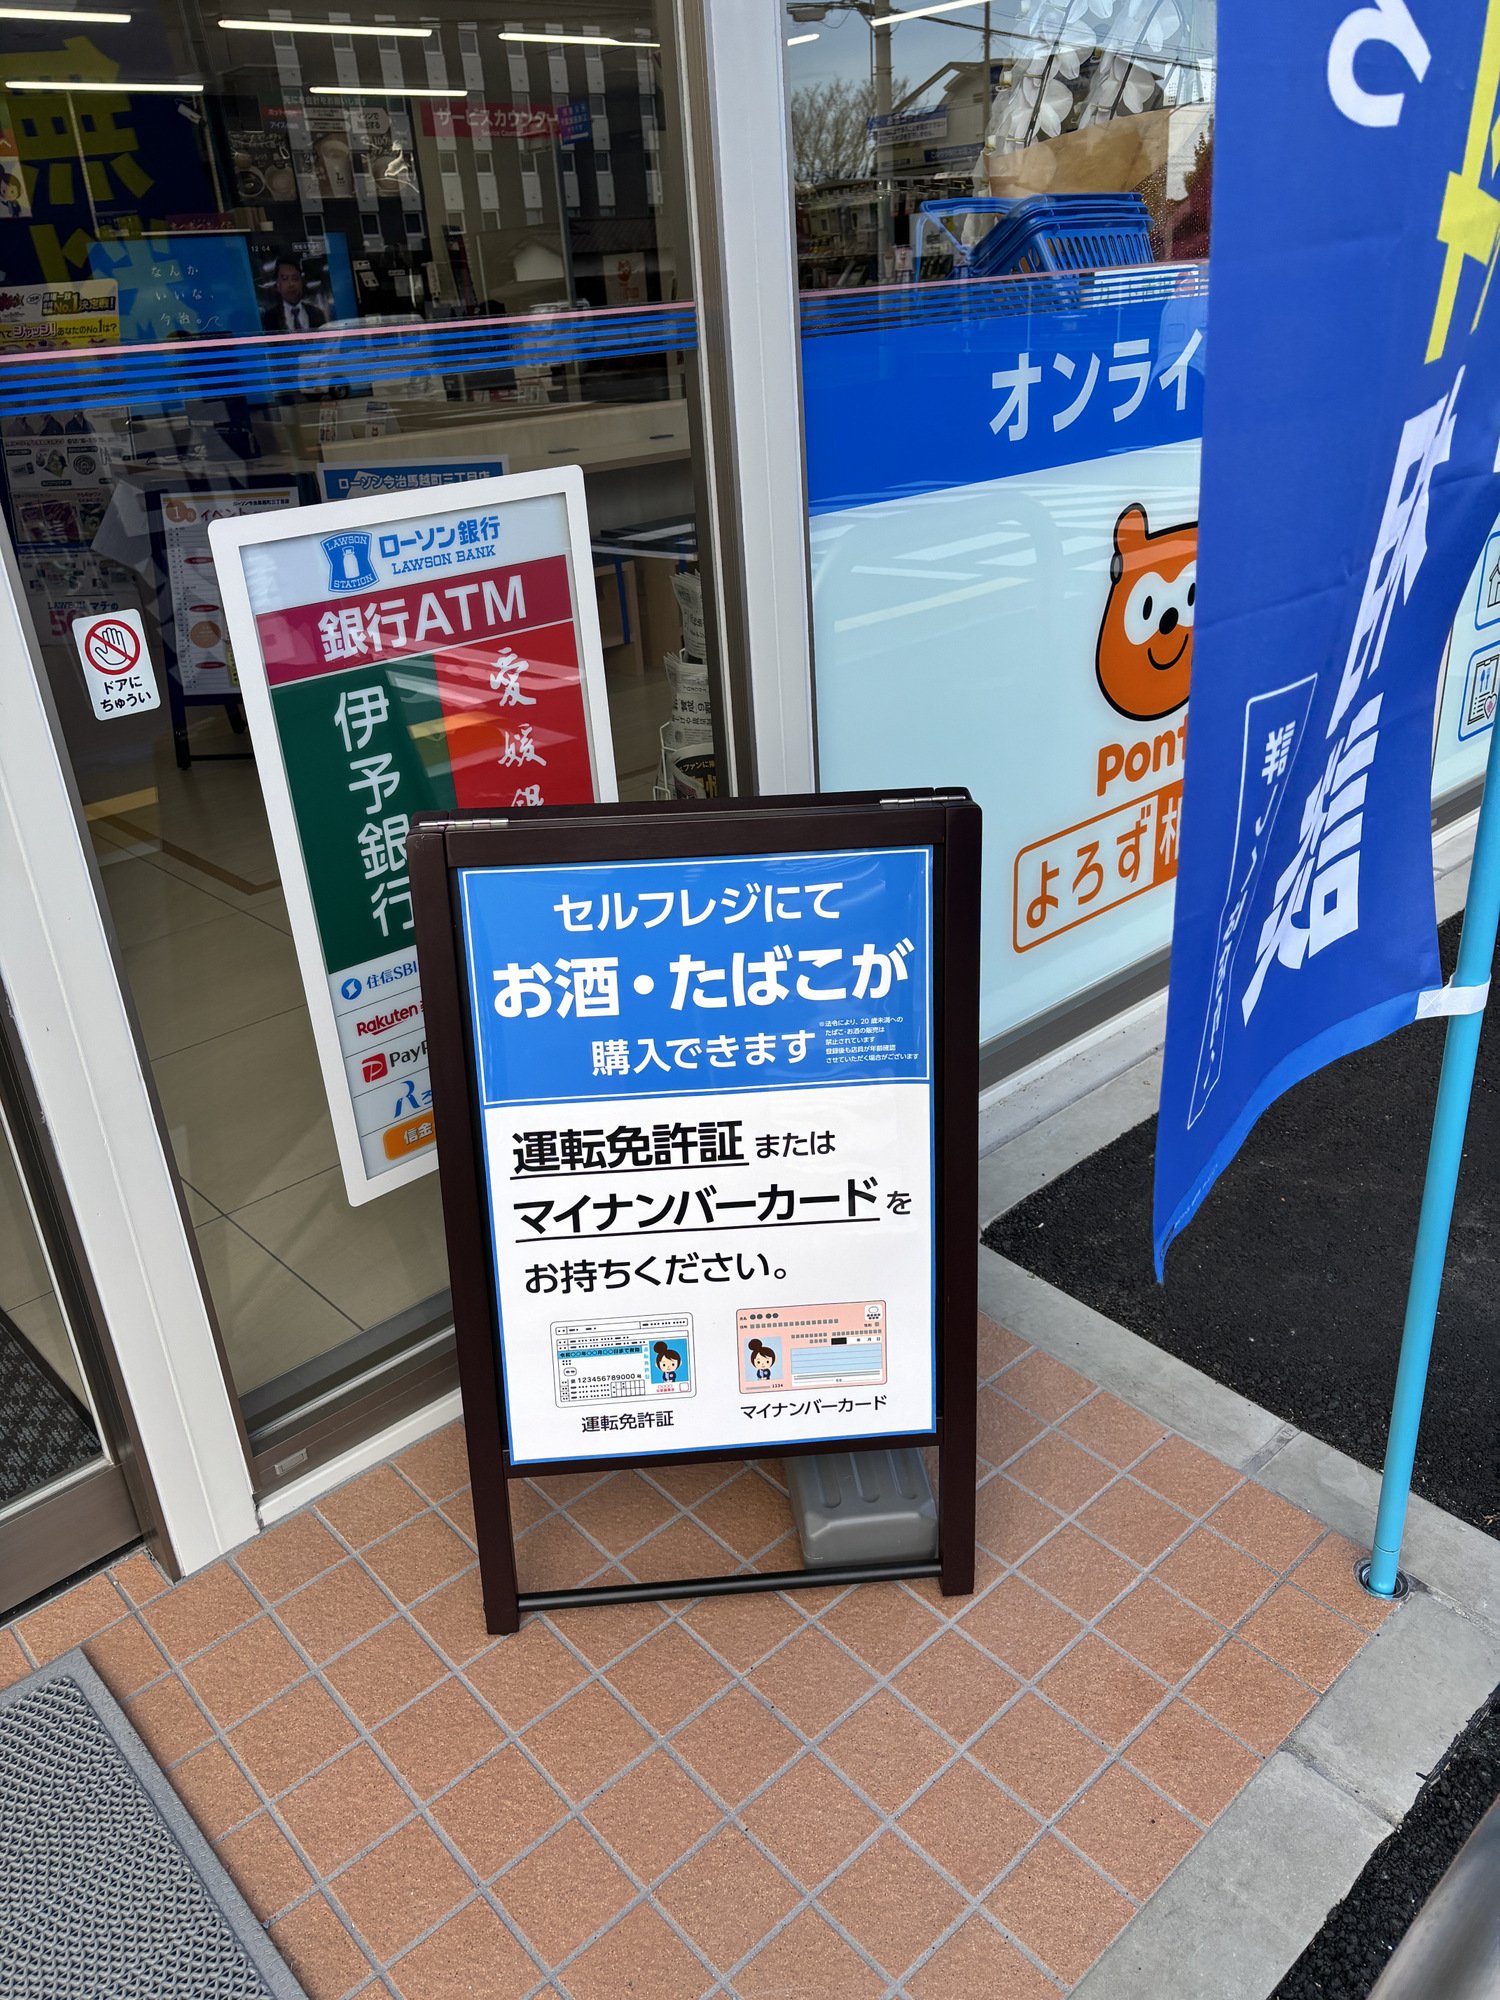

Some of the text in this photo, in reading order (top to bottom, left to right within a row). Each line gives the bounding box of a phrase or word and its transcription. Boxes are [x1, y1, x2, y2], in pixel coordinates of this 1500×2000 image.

[151, 264, 200, 279] なんか
[989, 328, 1203, 442] オンライ
[325, 534, 369, 553] LAWSON
[379, 515, 501, 559] ローソン銀行
[392, 543, 497, 575] LAWSON BANK
[333, 573, 375, 591] STATION
[317, 574, 527, 663] 銀行ATM
[102, 676, 143, 695] ドアに
[100, 691, 152, 713] ちゅうい
[333, 684, 416, 938] 伊予銀行
[553, 882, 844, 932] セルフレジにて
[492, 937, 916, 1020] お酒・たばこが
[356, 1003, 419, 1037] Rakuten
[591, 1029, 816, 1078] 購入できます
[825, 1035, 876, 1046] 禁止されています
[826, 1053, 920, 1064] させていただく場合がございます
[404, 1121, 433, 1146] 信金
[511, 1119, 837, 1175] 運転免許証 または
[512, 1175, 913, 1236] マイナンバーカード を
[524, 1252, 789, 1295] お持ちください。
[577, 1372, 636, 1384] 123456789000
[581, 1411, 675, 1434] 運転免許証
[740, 1394, 888, 1420] マイナンバーカード
